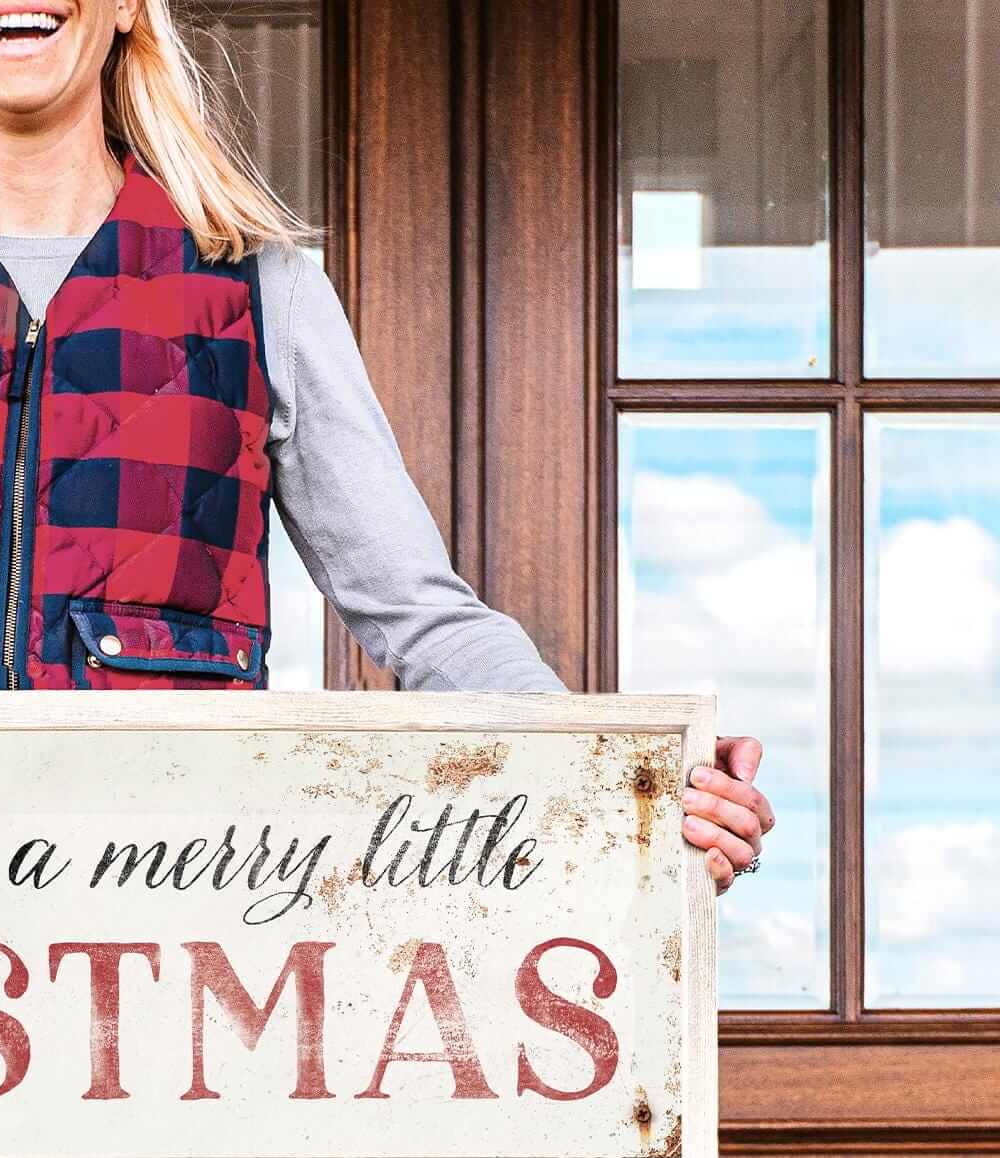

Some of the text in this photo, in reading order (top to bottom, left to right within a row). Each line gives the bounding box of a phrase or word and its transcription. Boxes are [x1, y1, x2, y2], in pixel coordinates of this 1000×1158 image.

[8, 838, 72, 891] a
[89, 824, 332, 926] merry
[361, 794, 545, 891] little
